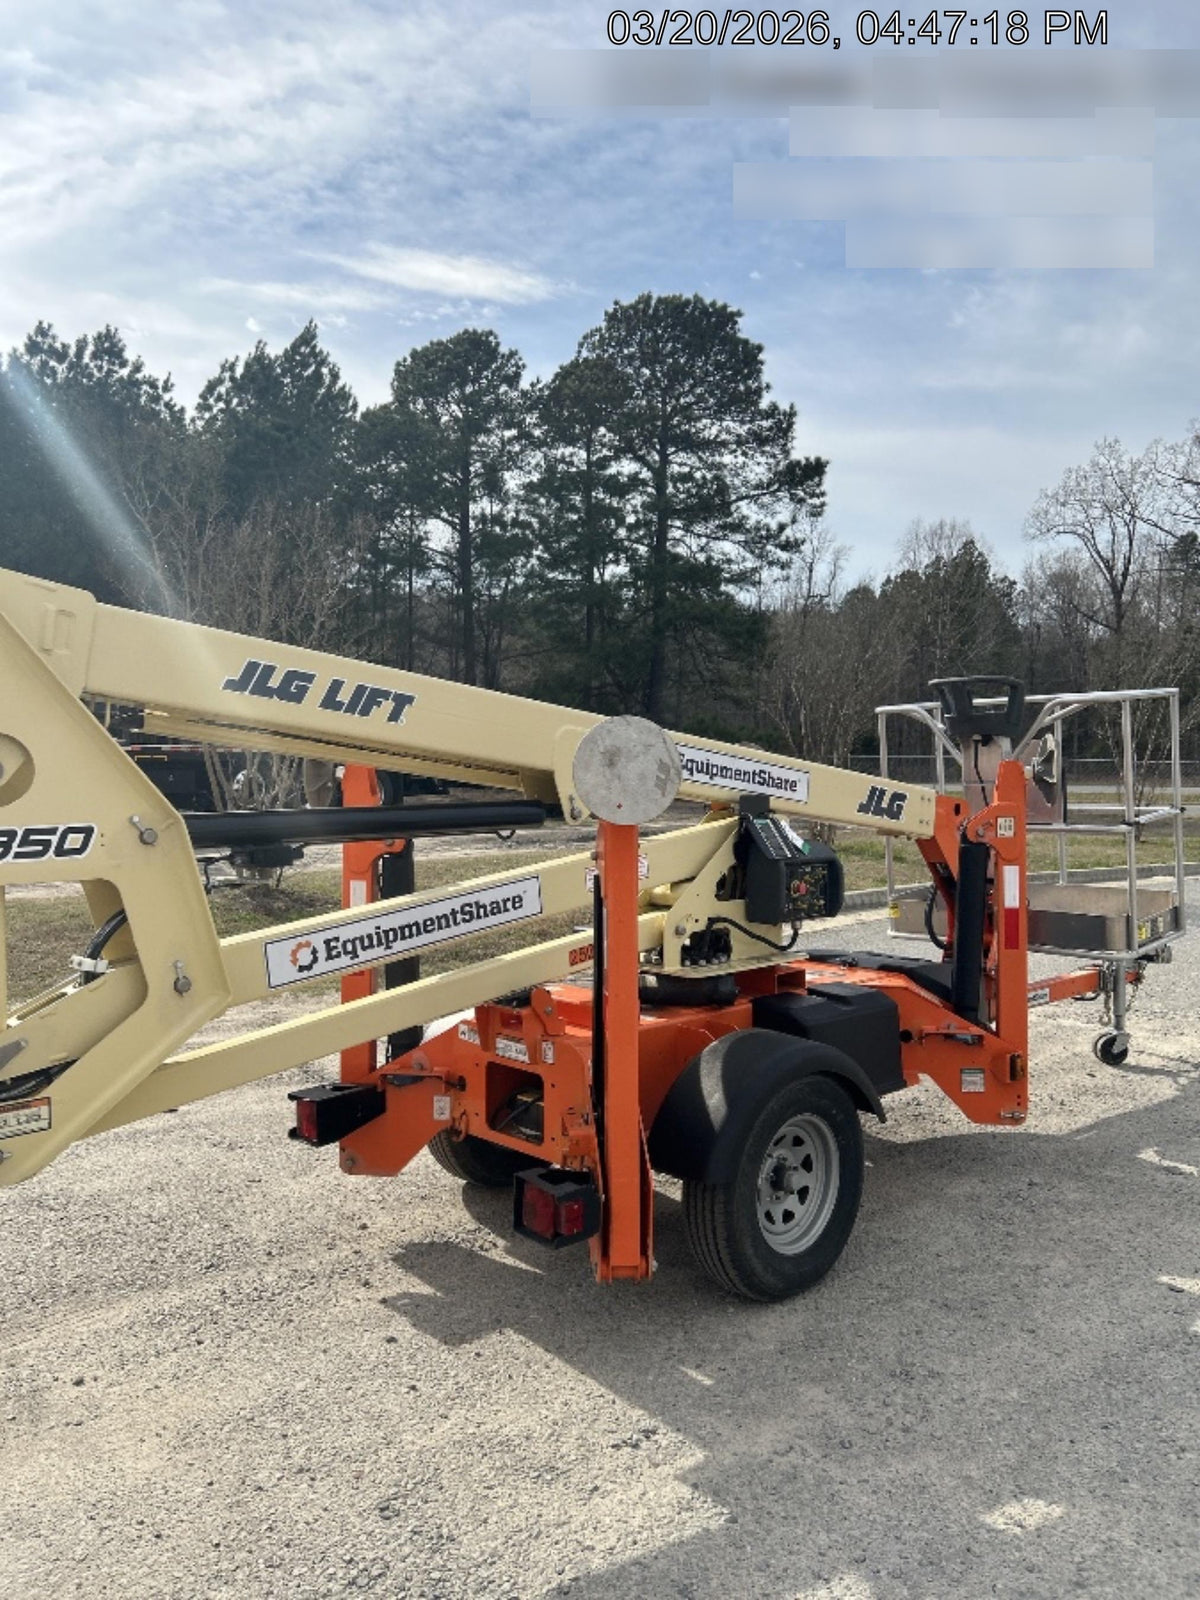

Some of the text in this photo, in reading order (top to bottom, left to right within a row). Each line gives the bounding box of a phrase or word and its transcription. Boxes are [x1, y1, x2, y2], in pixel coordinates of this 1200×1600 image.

[221, 659, 418, 723] JLG LIFT
[857, 784, 909, 822] JLG
[323, 893, 525, 963] EquipmentShare
